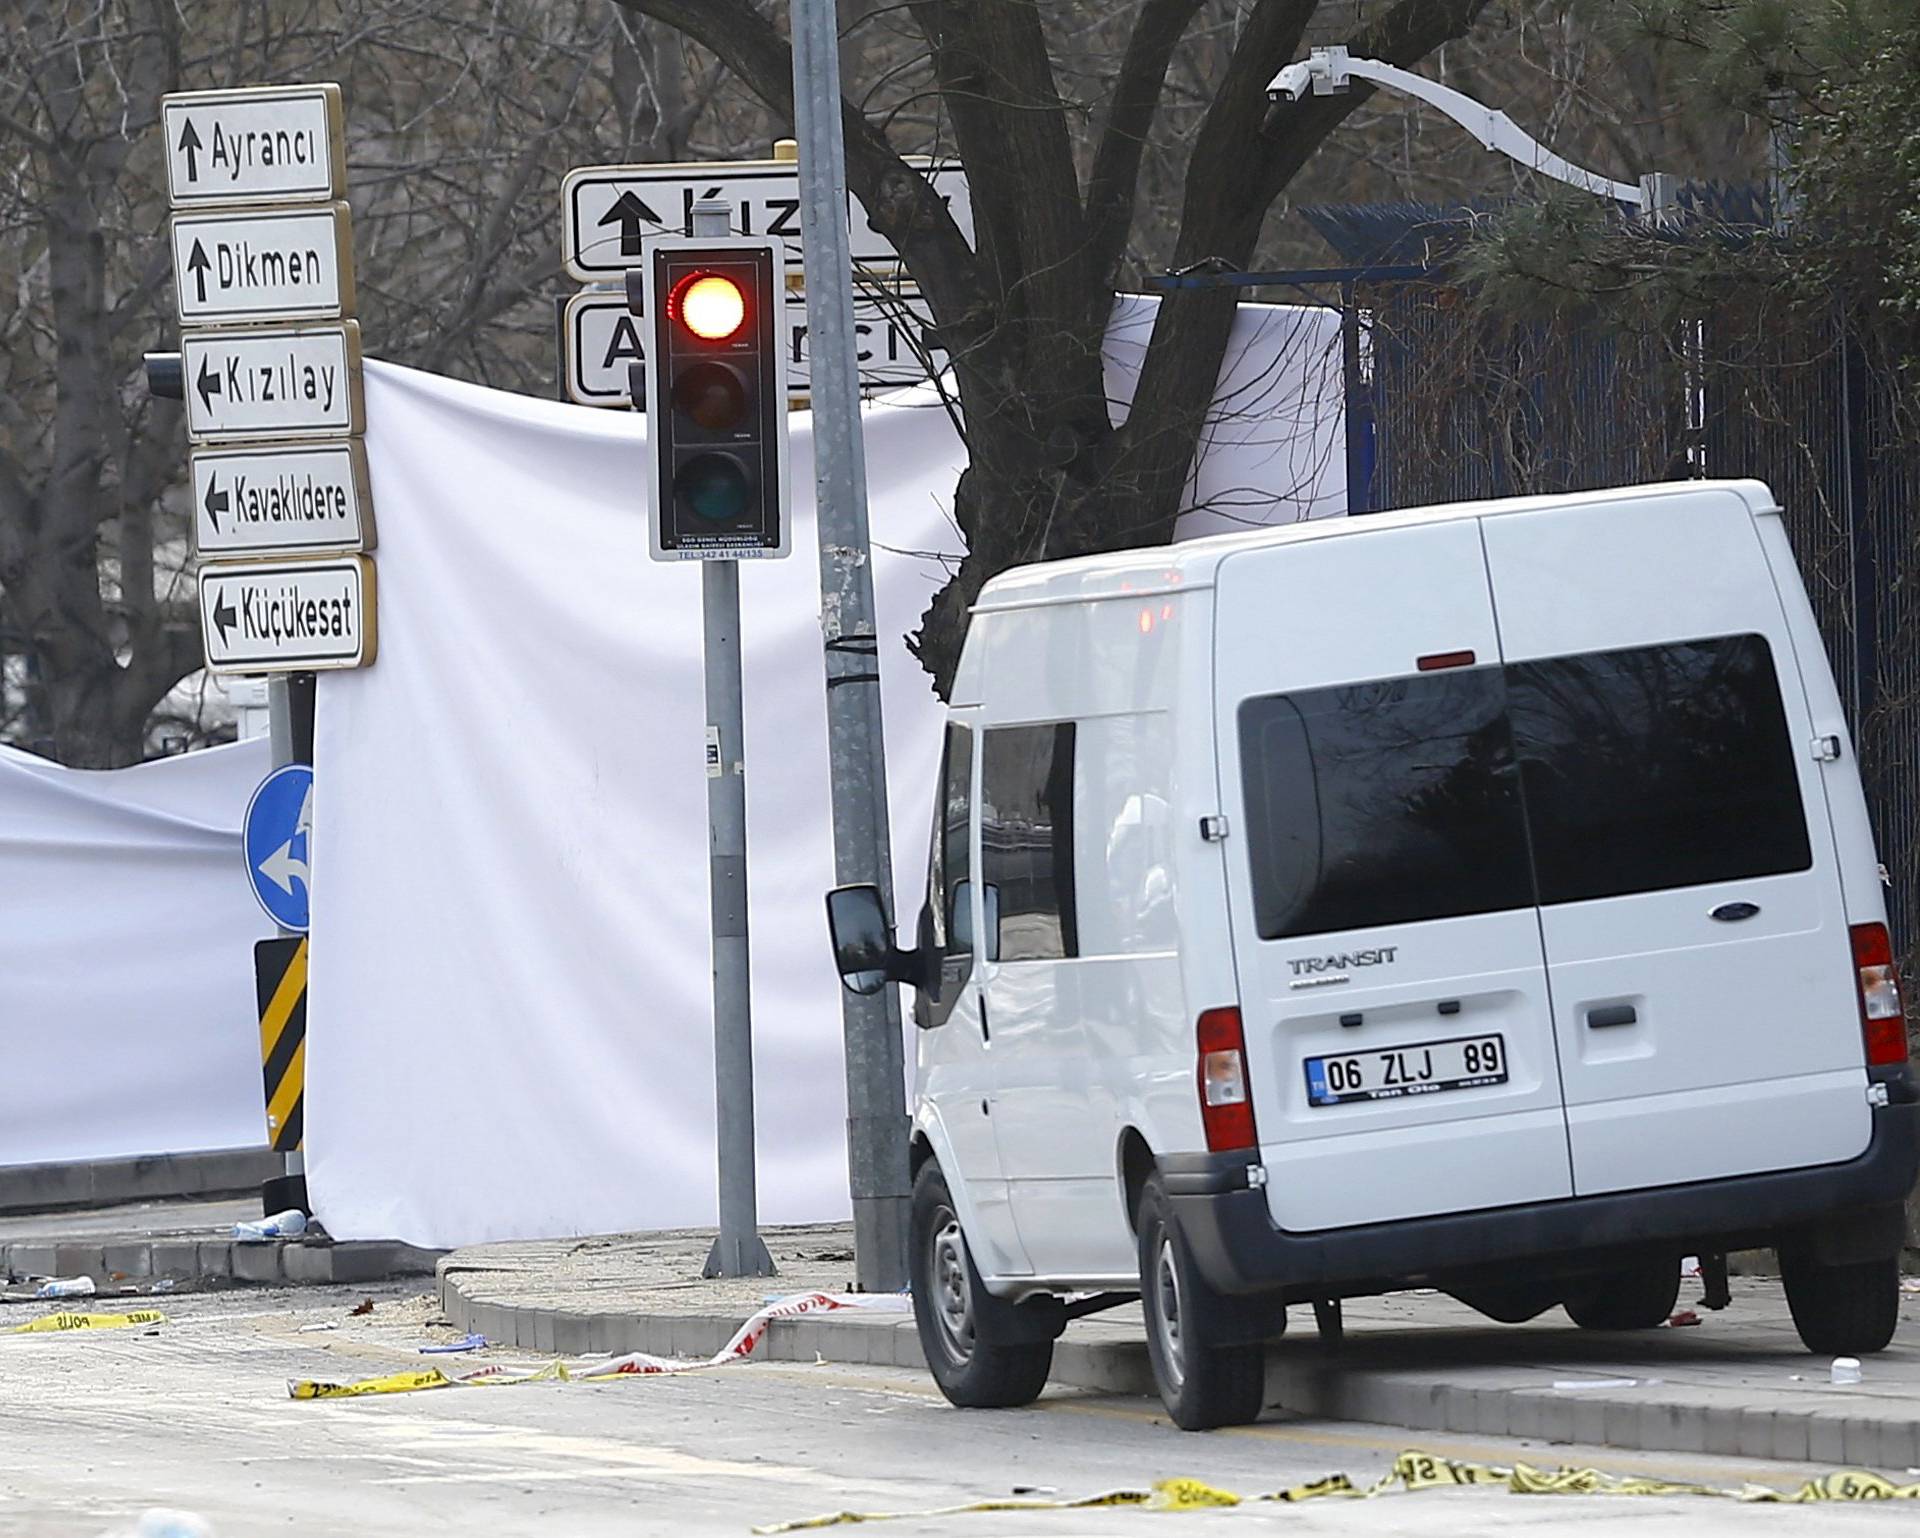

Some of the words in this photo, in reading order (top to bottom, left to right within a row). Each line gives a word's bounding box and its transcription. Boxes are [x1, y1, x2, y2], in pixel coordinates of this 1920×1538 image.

[212, 121, 315, 181] Ayrancı
[217, 241, 320, 289] Dikmen
[226, 352, 335, 412] Kızılay
[234, 473, 346, 523] Kavaklıdere
[241, 584, 352, 646] Küçükesat
[1287, 946, 1398, 975] TRANSIT
[1327, 1059, 1362, 1091] 06
[1380, 1049, 1433, 1085] ZLJ
[1463, 1041, 1498, 1073] 89
